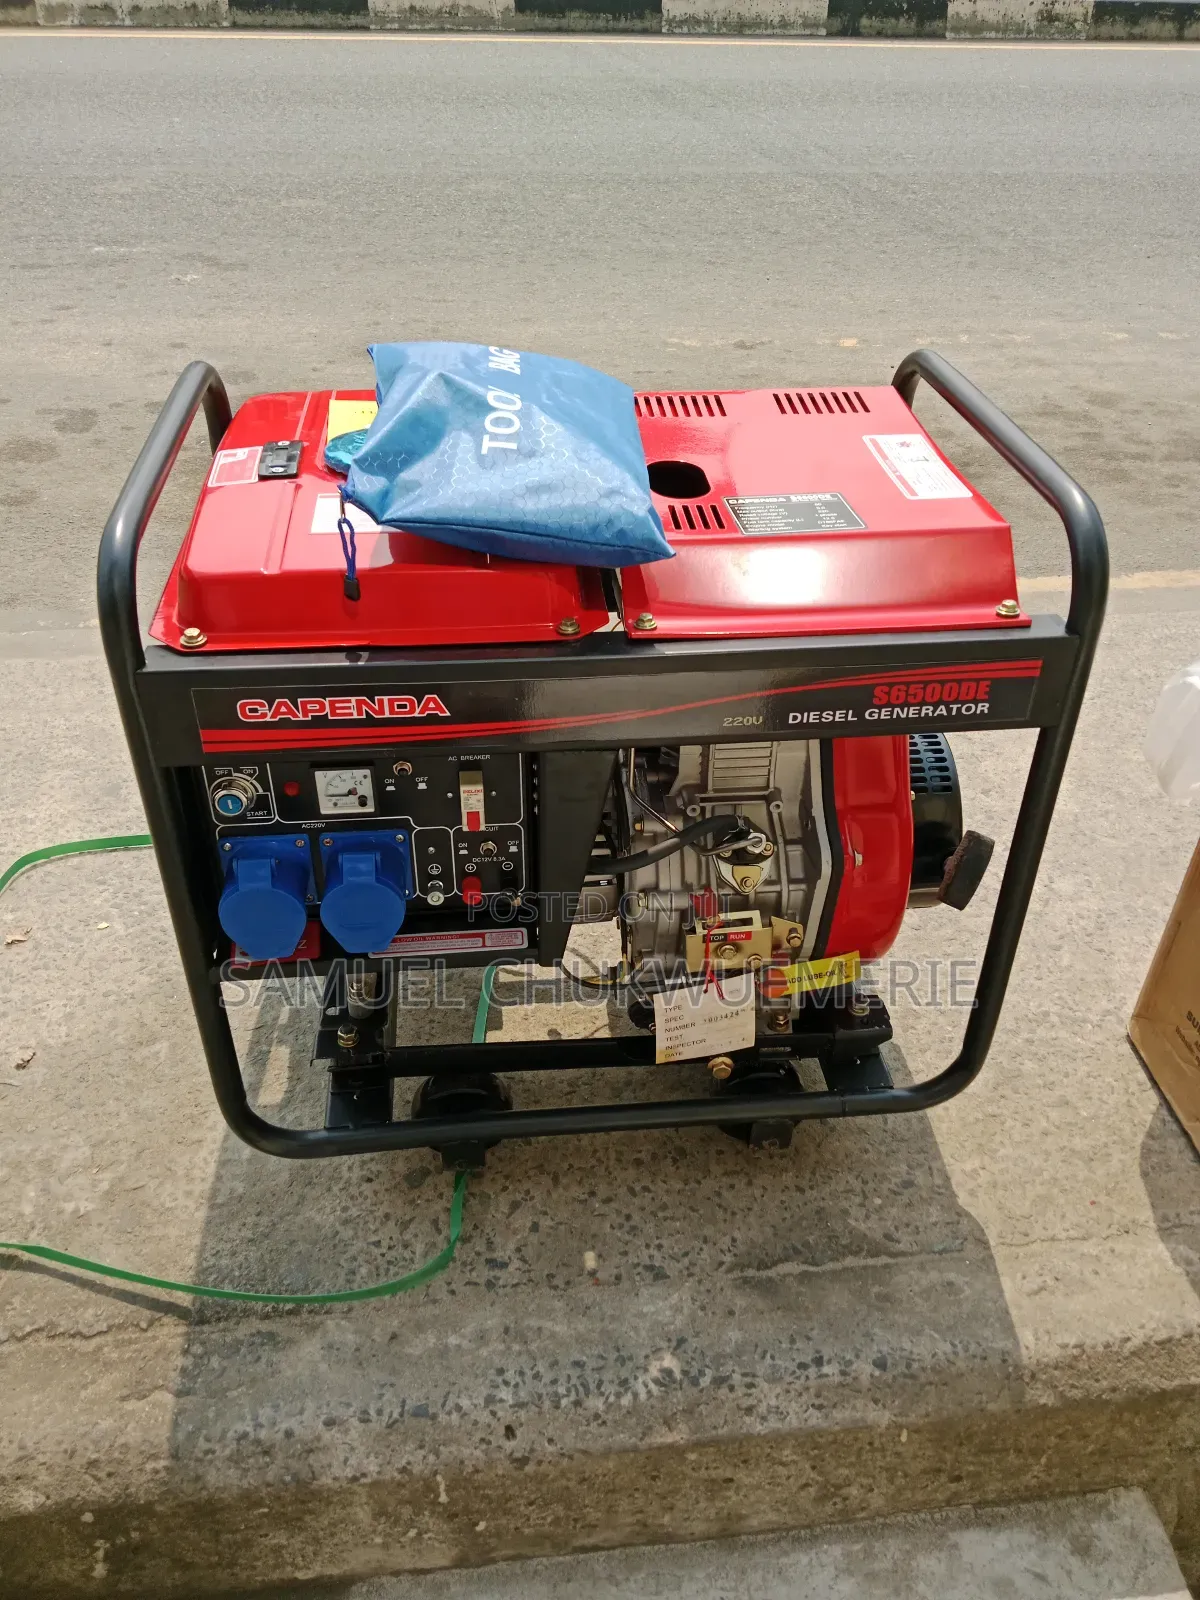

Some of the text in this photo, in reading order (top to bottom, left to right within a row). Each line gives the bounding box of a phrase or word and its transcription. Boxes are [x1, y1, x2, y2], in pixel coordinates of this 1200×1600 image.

[872, 680, 991, 705] S6500DE
[237, 695, 450, 722] CAPENDA
[788, 703, 990, 724] DIESEL GENERATOR
[723, 716, 763, 727] 220V
[664, 1005, 683, 1013] TYPE
[664, 1014, 684, 1024] SPEC
[664, 1022, 696, 1033] NUMBER
[666, 1034, 684, 1042] TEST
[665, 1038, 706, 1051] INSPECTOR
[664, 1051, 684, 1059] DATE
